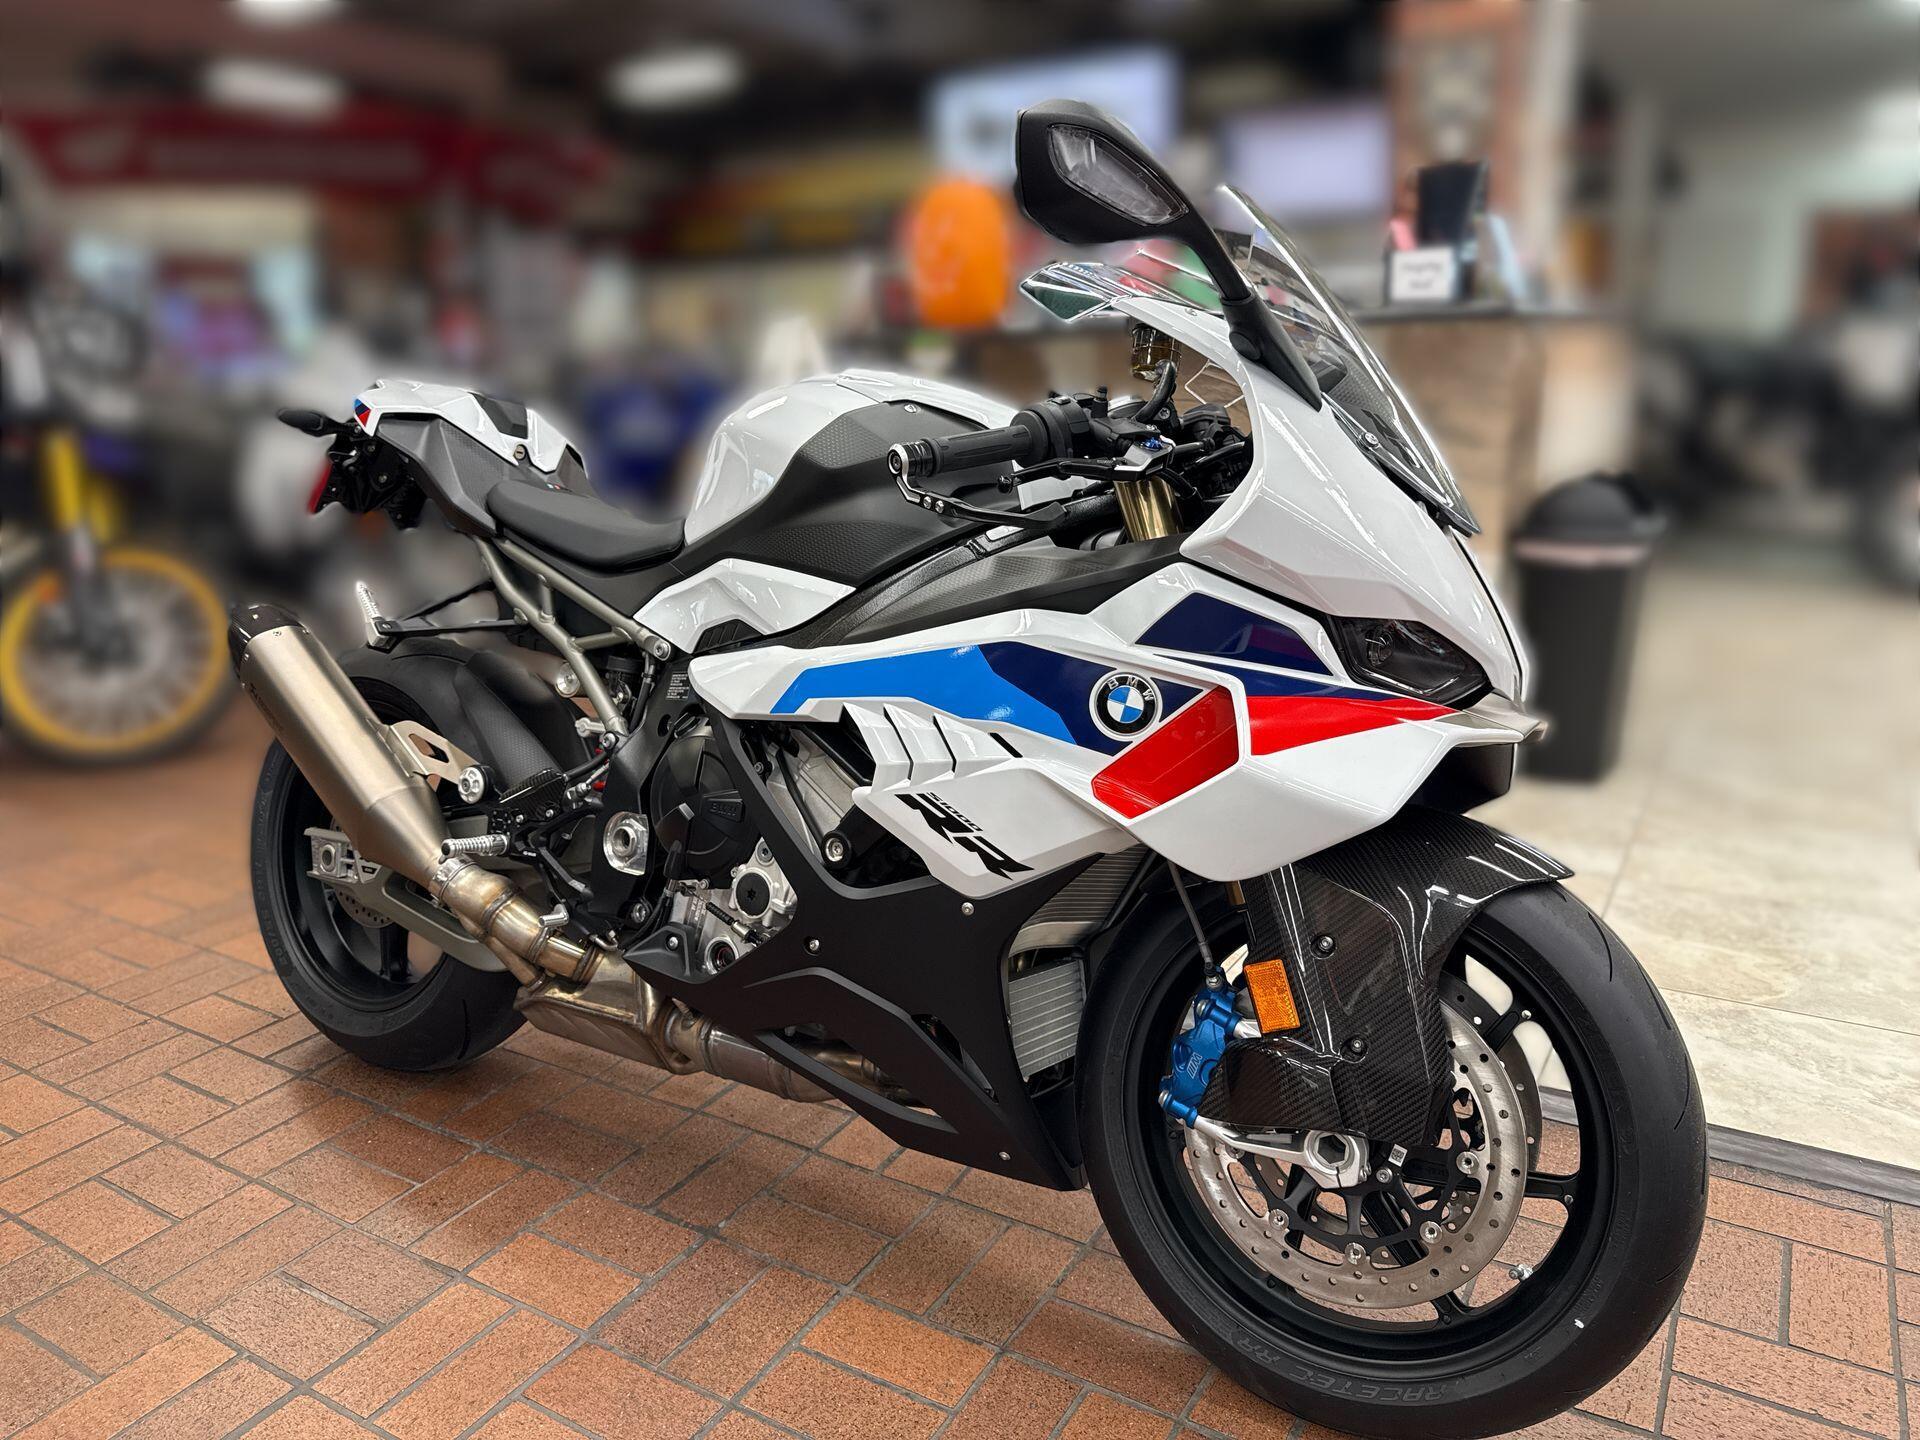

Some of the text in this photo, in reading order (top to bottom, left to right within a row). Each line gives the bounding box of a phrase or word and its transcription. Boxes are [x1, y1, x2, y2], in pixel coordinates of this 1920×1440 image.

[1107, 676, 1154, 701] BMW
[926, 792, 983, 831] S1000
[894, 793, 1034, 880] RR
[1289, 1365, 1447, 1401] RACETEC
